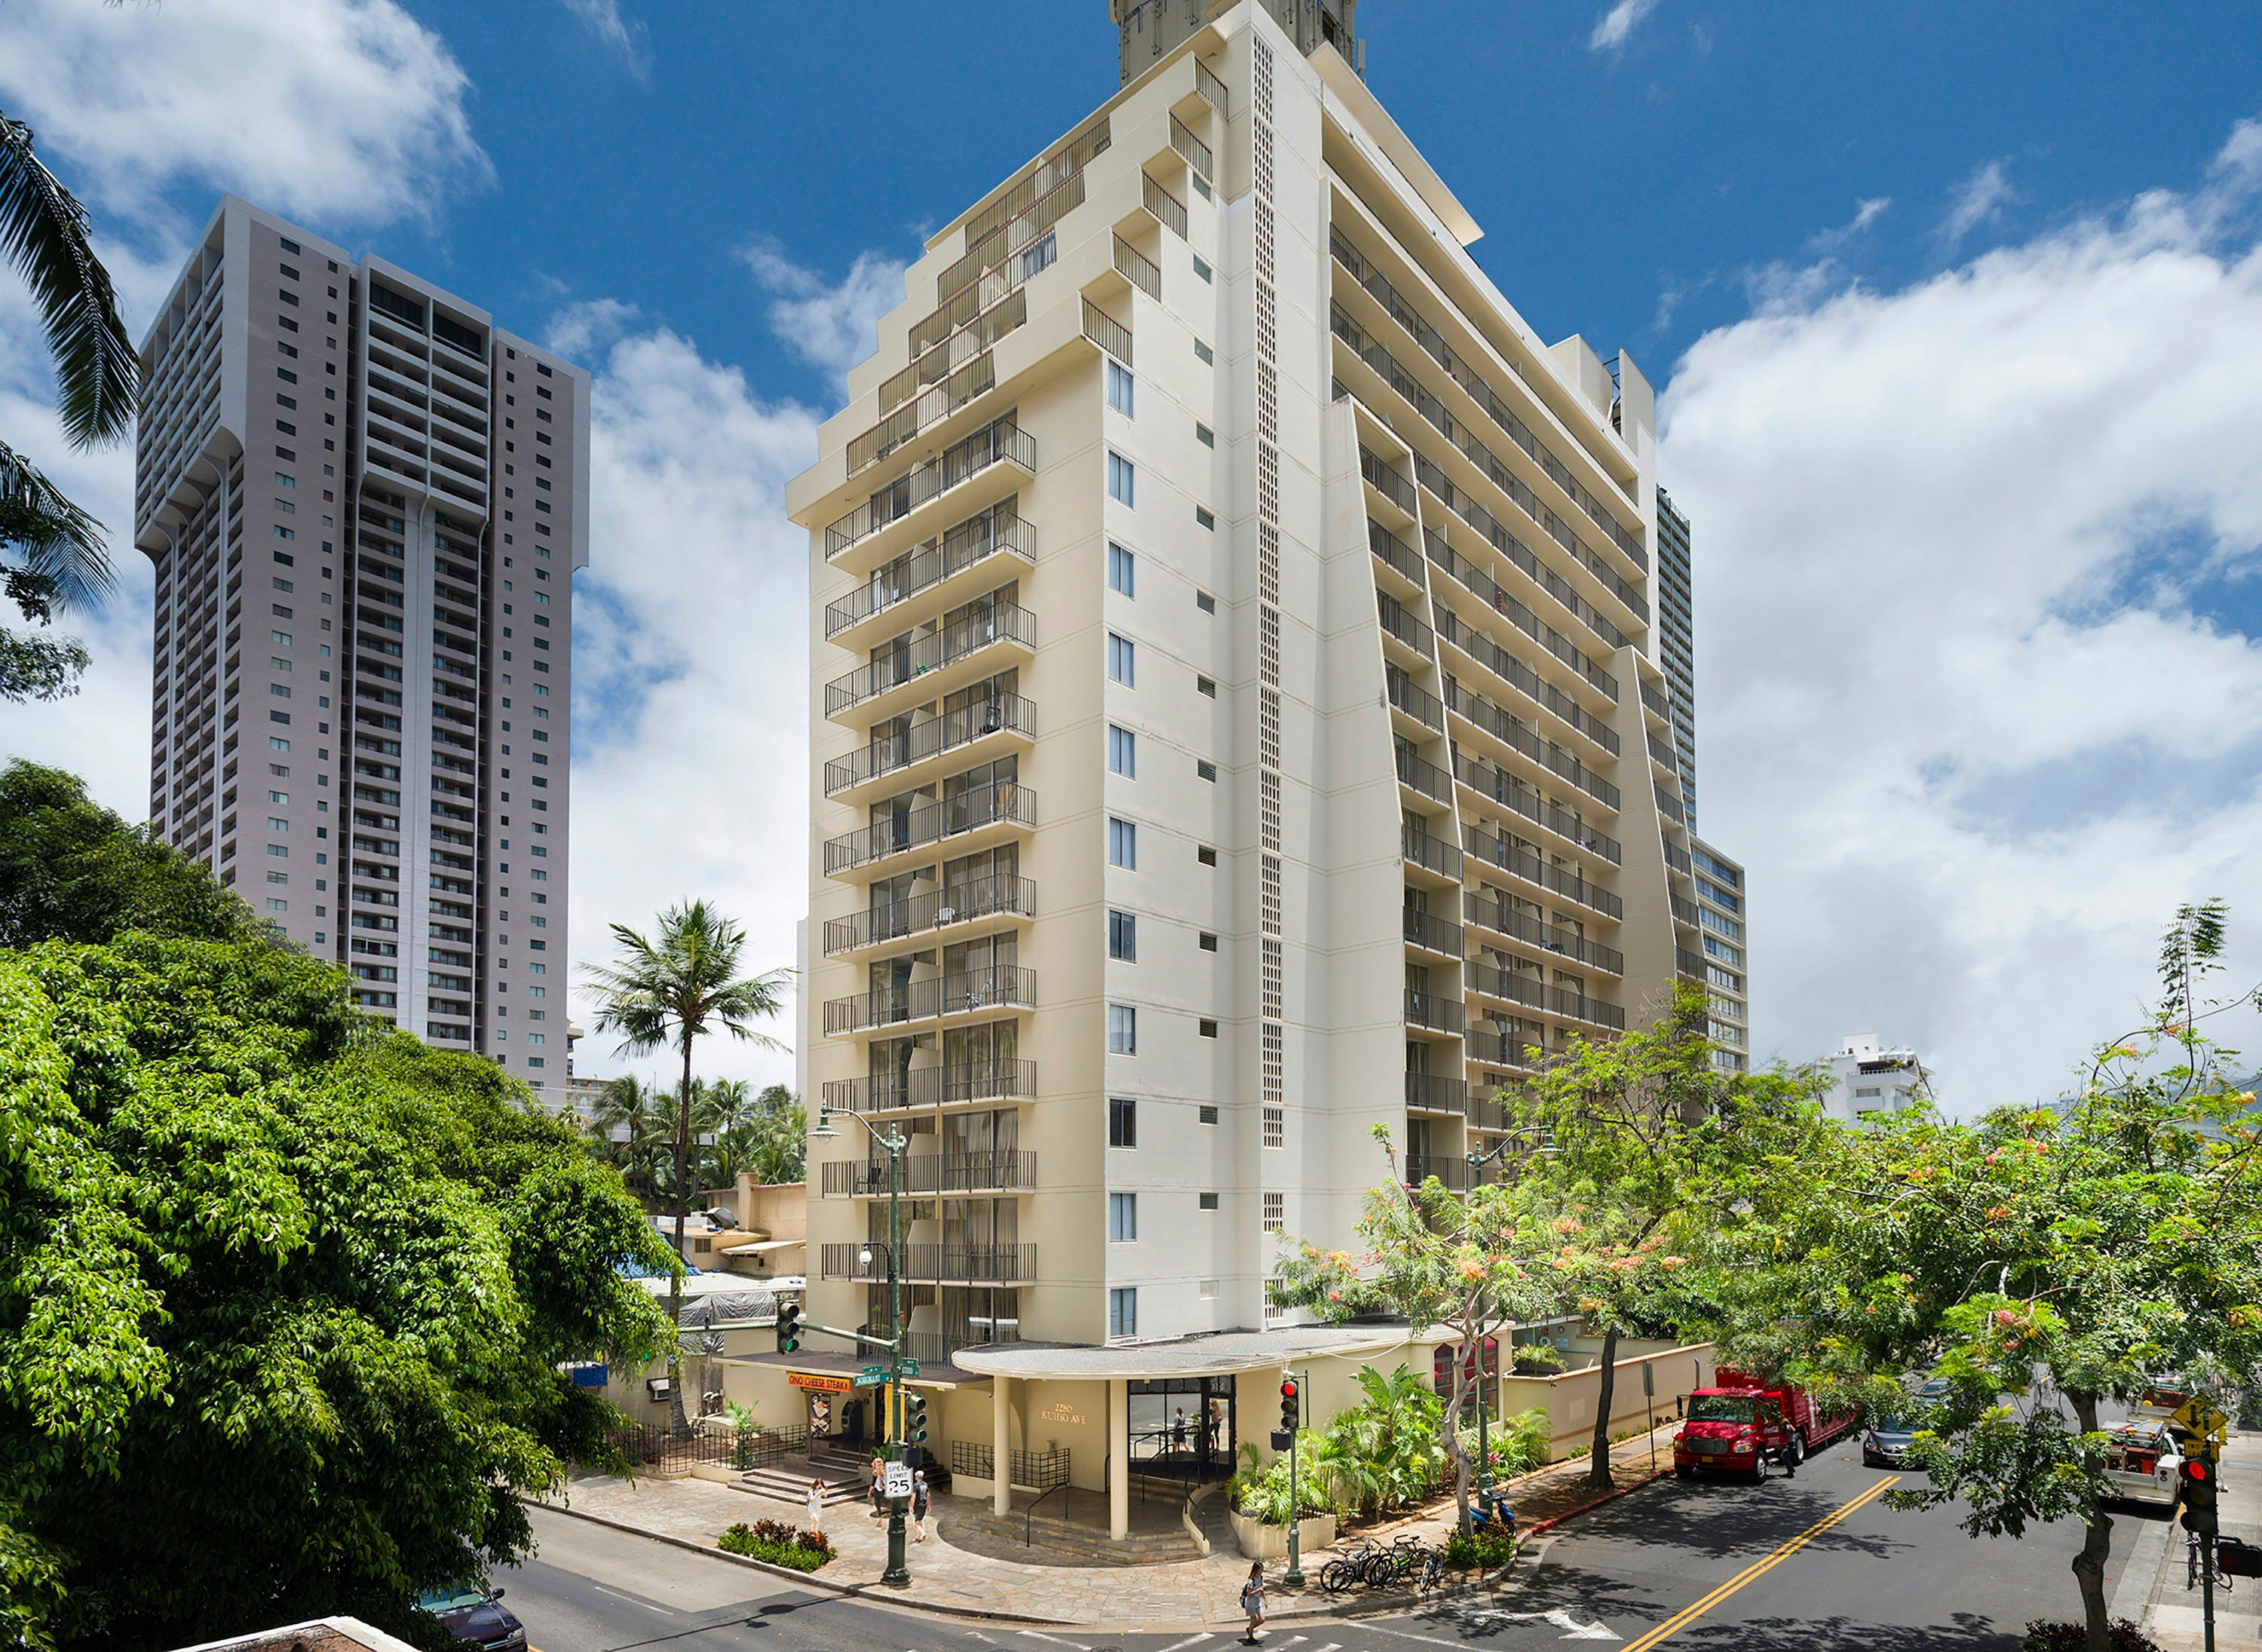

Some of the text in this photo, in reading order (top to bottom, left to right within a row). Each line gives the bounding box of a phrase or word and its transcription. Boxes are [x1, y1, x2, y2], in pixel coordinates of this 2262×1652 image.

[789, 1375, 803, 1385] ONO
[805, 1377, 825, 1387] CHEESE
[1056, 1403, 1072, 1412] 2280
[1041, 1411, 1086, 1424] KUHIO AVE
[889, 1480, 909, 1493] 25
